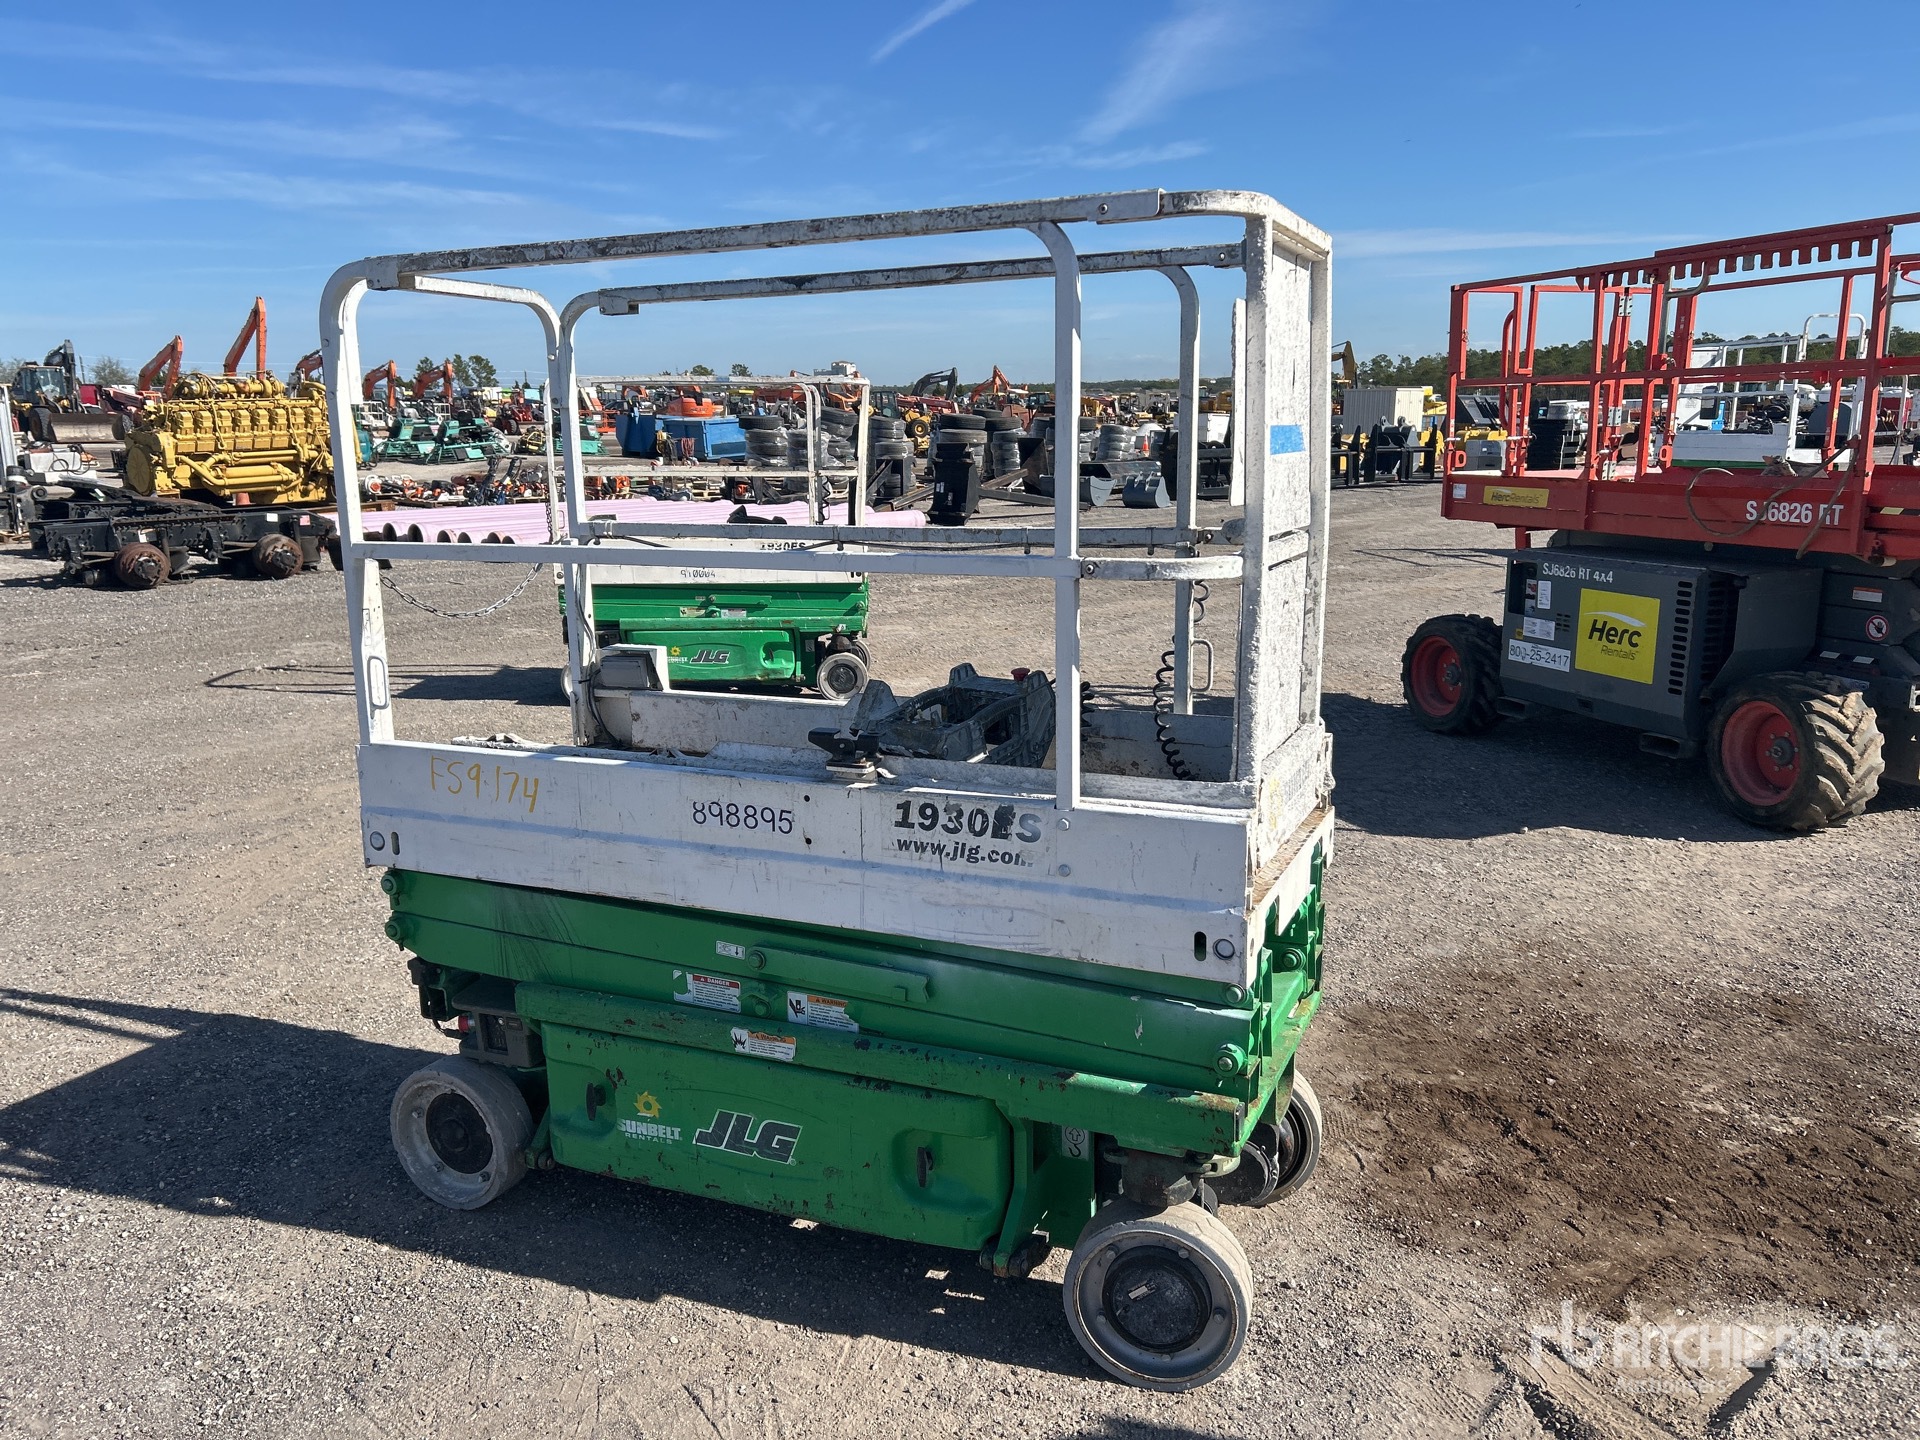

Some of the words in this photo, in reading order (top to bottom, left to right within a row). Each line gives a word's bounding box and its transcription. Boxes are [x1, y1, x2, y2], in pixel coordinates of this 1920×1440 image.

[1818, 503, 1844, 525] RT
[1578, 566, 1590, 580] RT
[1588, 618, 1642, 648] Herc
[689, 649, 730, 664] JLG
[1600, 645, 1637, 661] Rentals
[692, 801, 794, 835] 898895
[894, 799, 1043, 844] 1930ES
[707, 977, 730, 987] DANGER
[821, 998, 848, 1008] WARNING
[616, 1118, 682, 1141] SUNBELT
[625, 1132, 673, 1145] RENTALS
[693, 1108, 804, 1165] JLG
